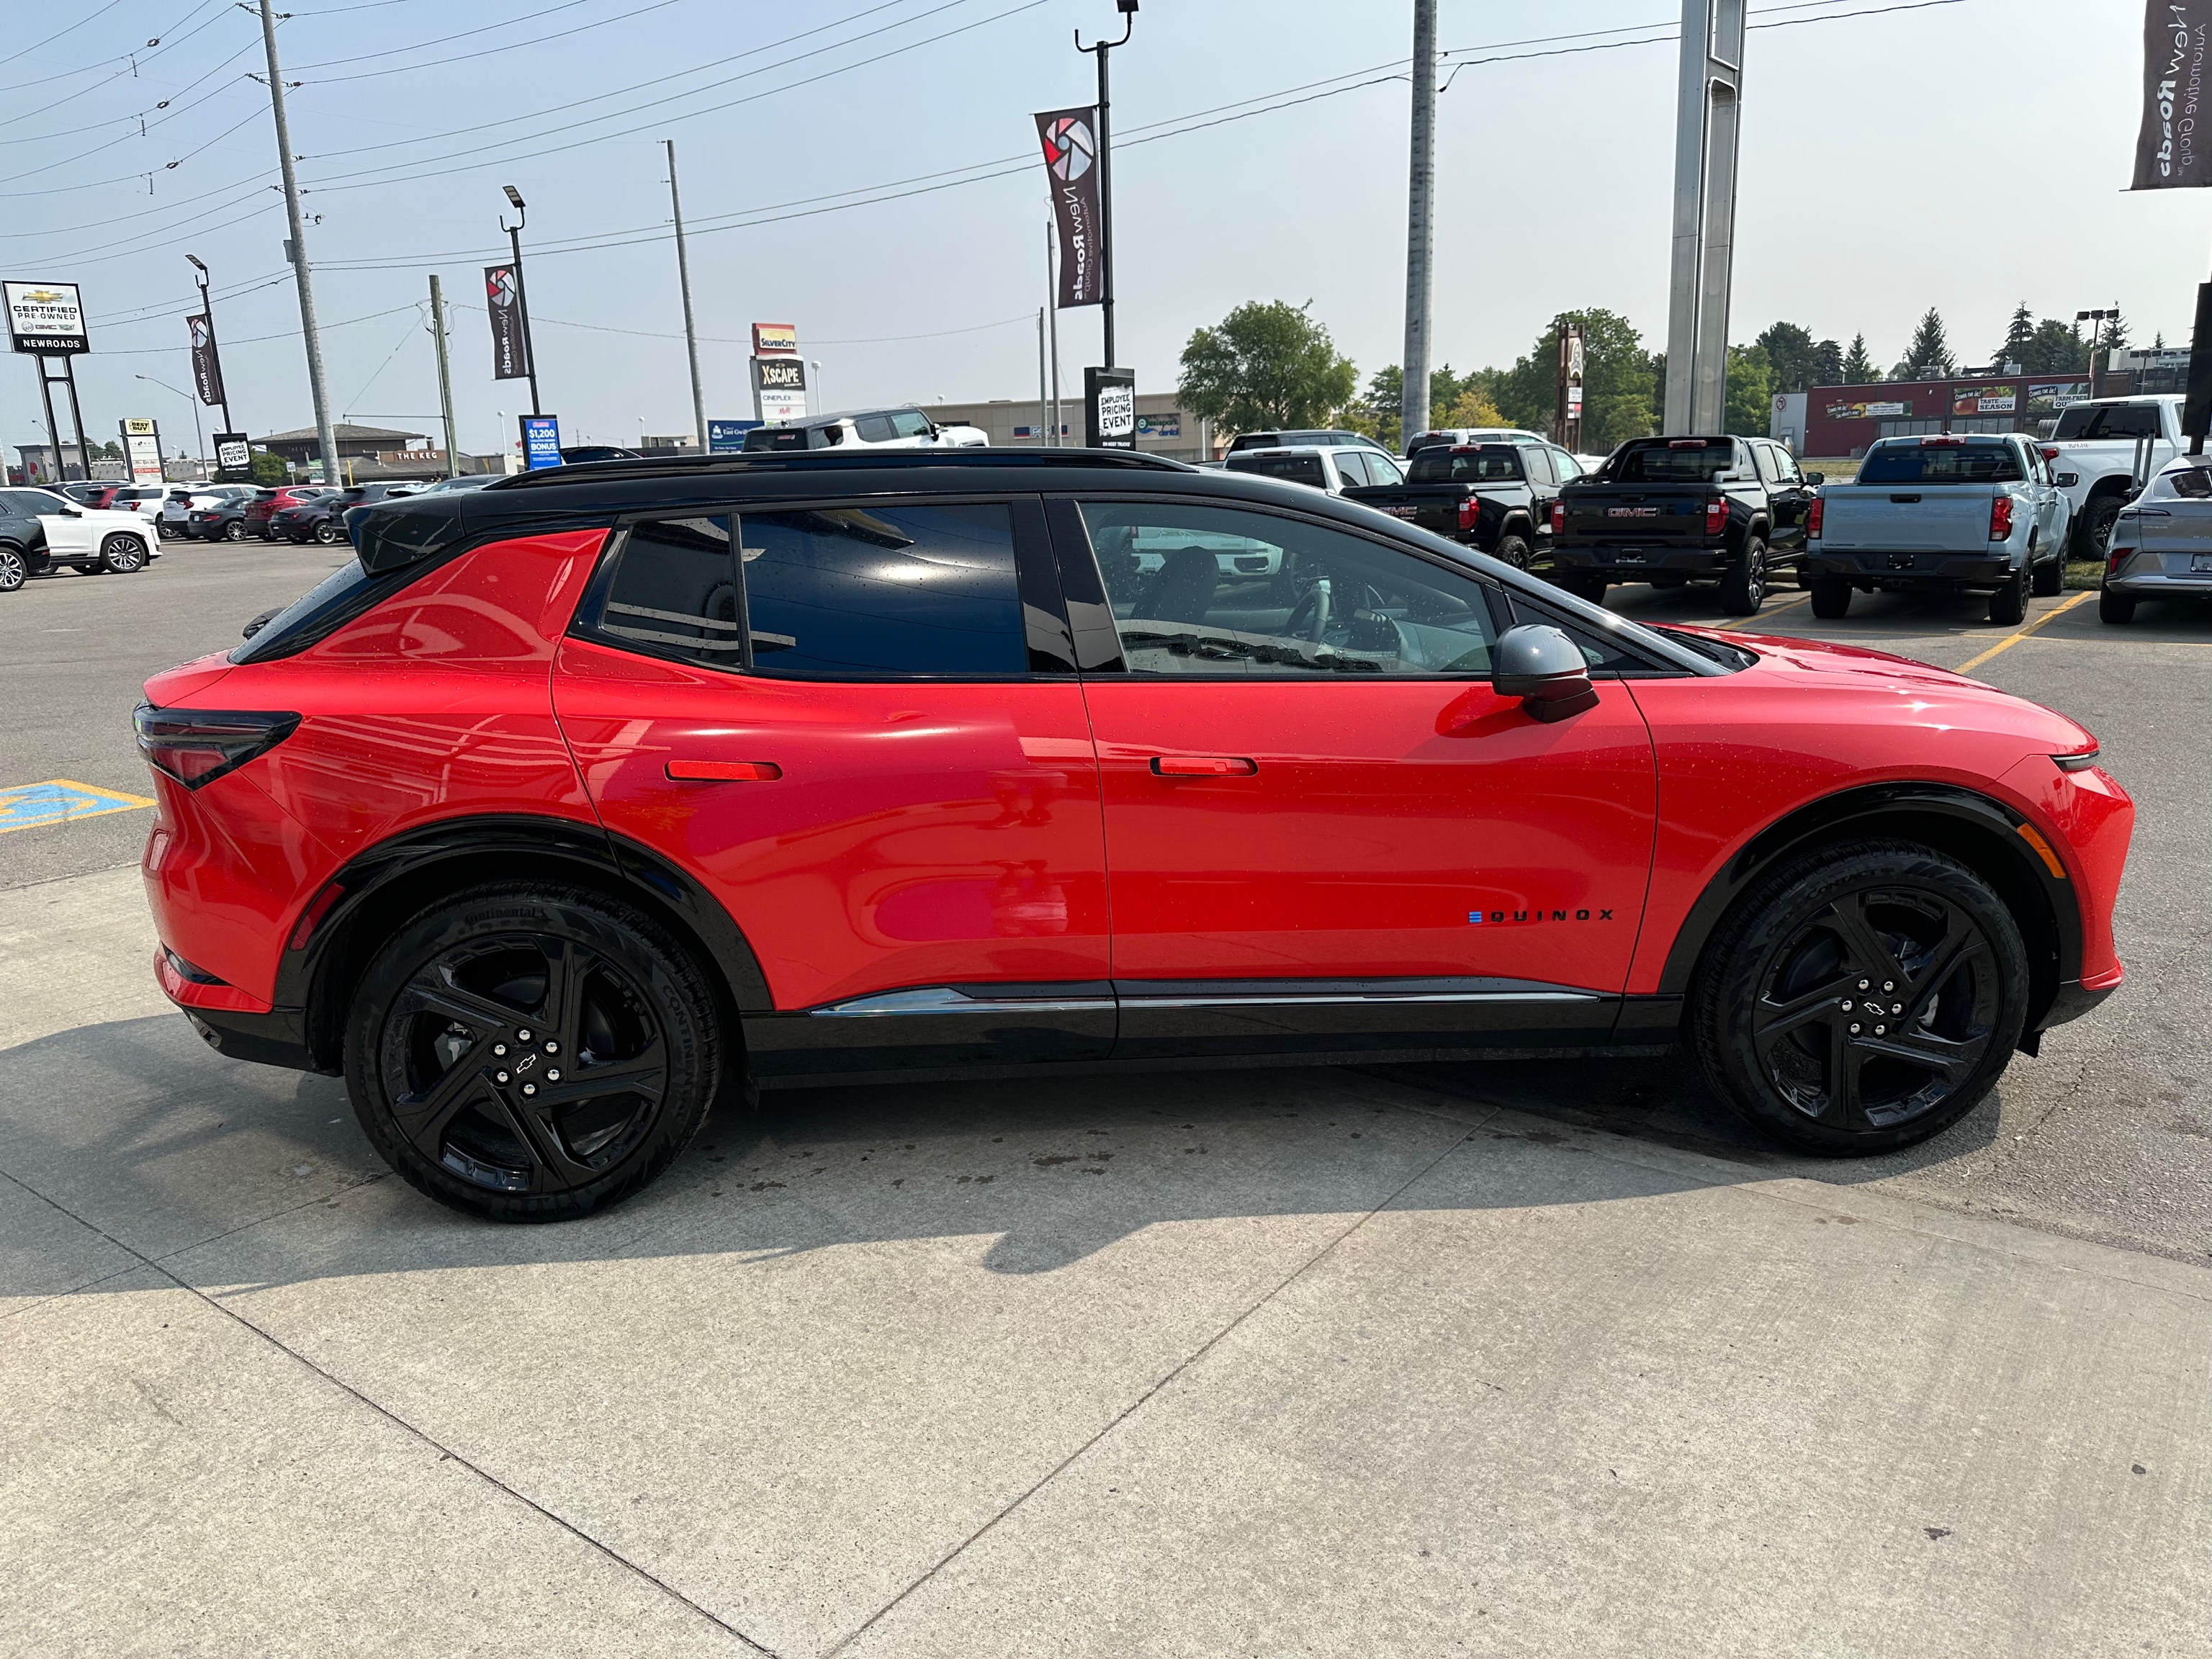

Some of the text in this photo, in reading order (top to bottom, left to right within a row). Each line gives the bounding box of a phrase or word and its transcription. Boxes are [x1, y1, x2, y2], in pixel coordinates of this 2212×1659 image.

[22, 339, 81, 349] NEWROADS
[761, 365, 799, 385] XSCAPE
[1101, 394, 1130, 406] EMPLOYEE
[1102, 403, 1131, 416] PRICING
[1102, 414, 1131, 429] EVENT
[529, 428, 555, 439] $1,200
[223, 454, 247, 463] EVENT
[1608, 508, 1656, 517] GMC
[464, 907, 536, 925] Continental
[1468, 909, 1614, 924] EQUINOX
